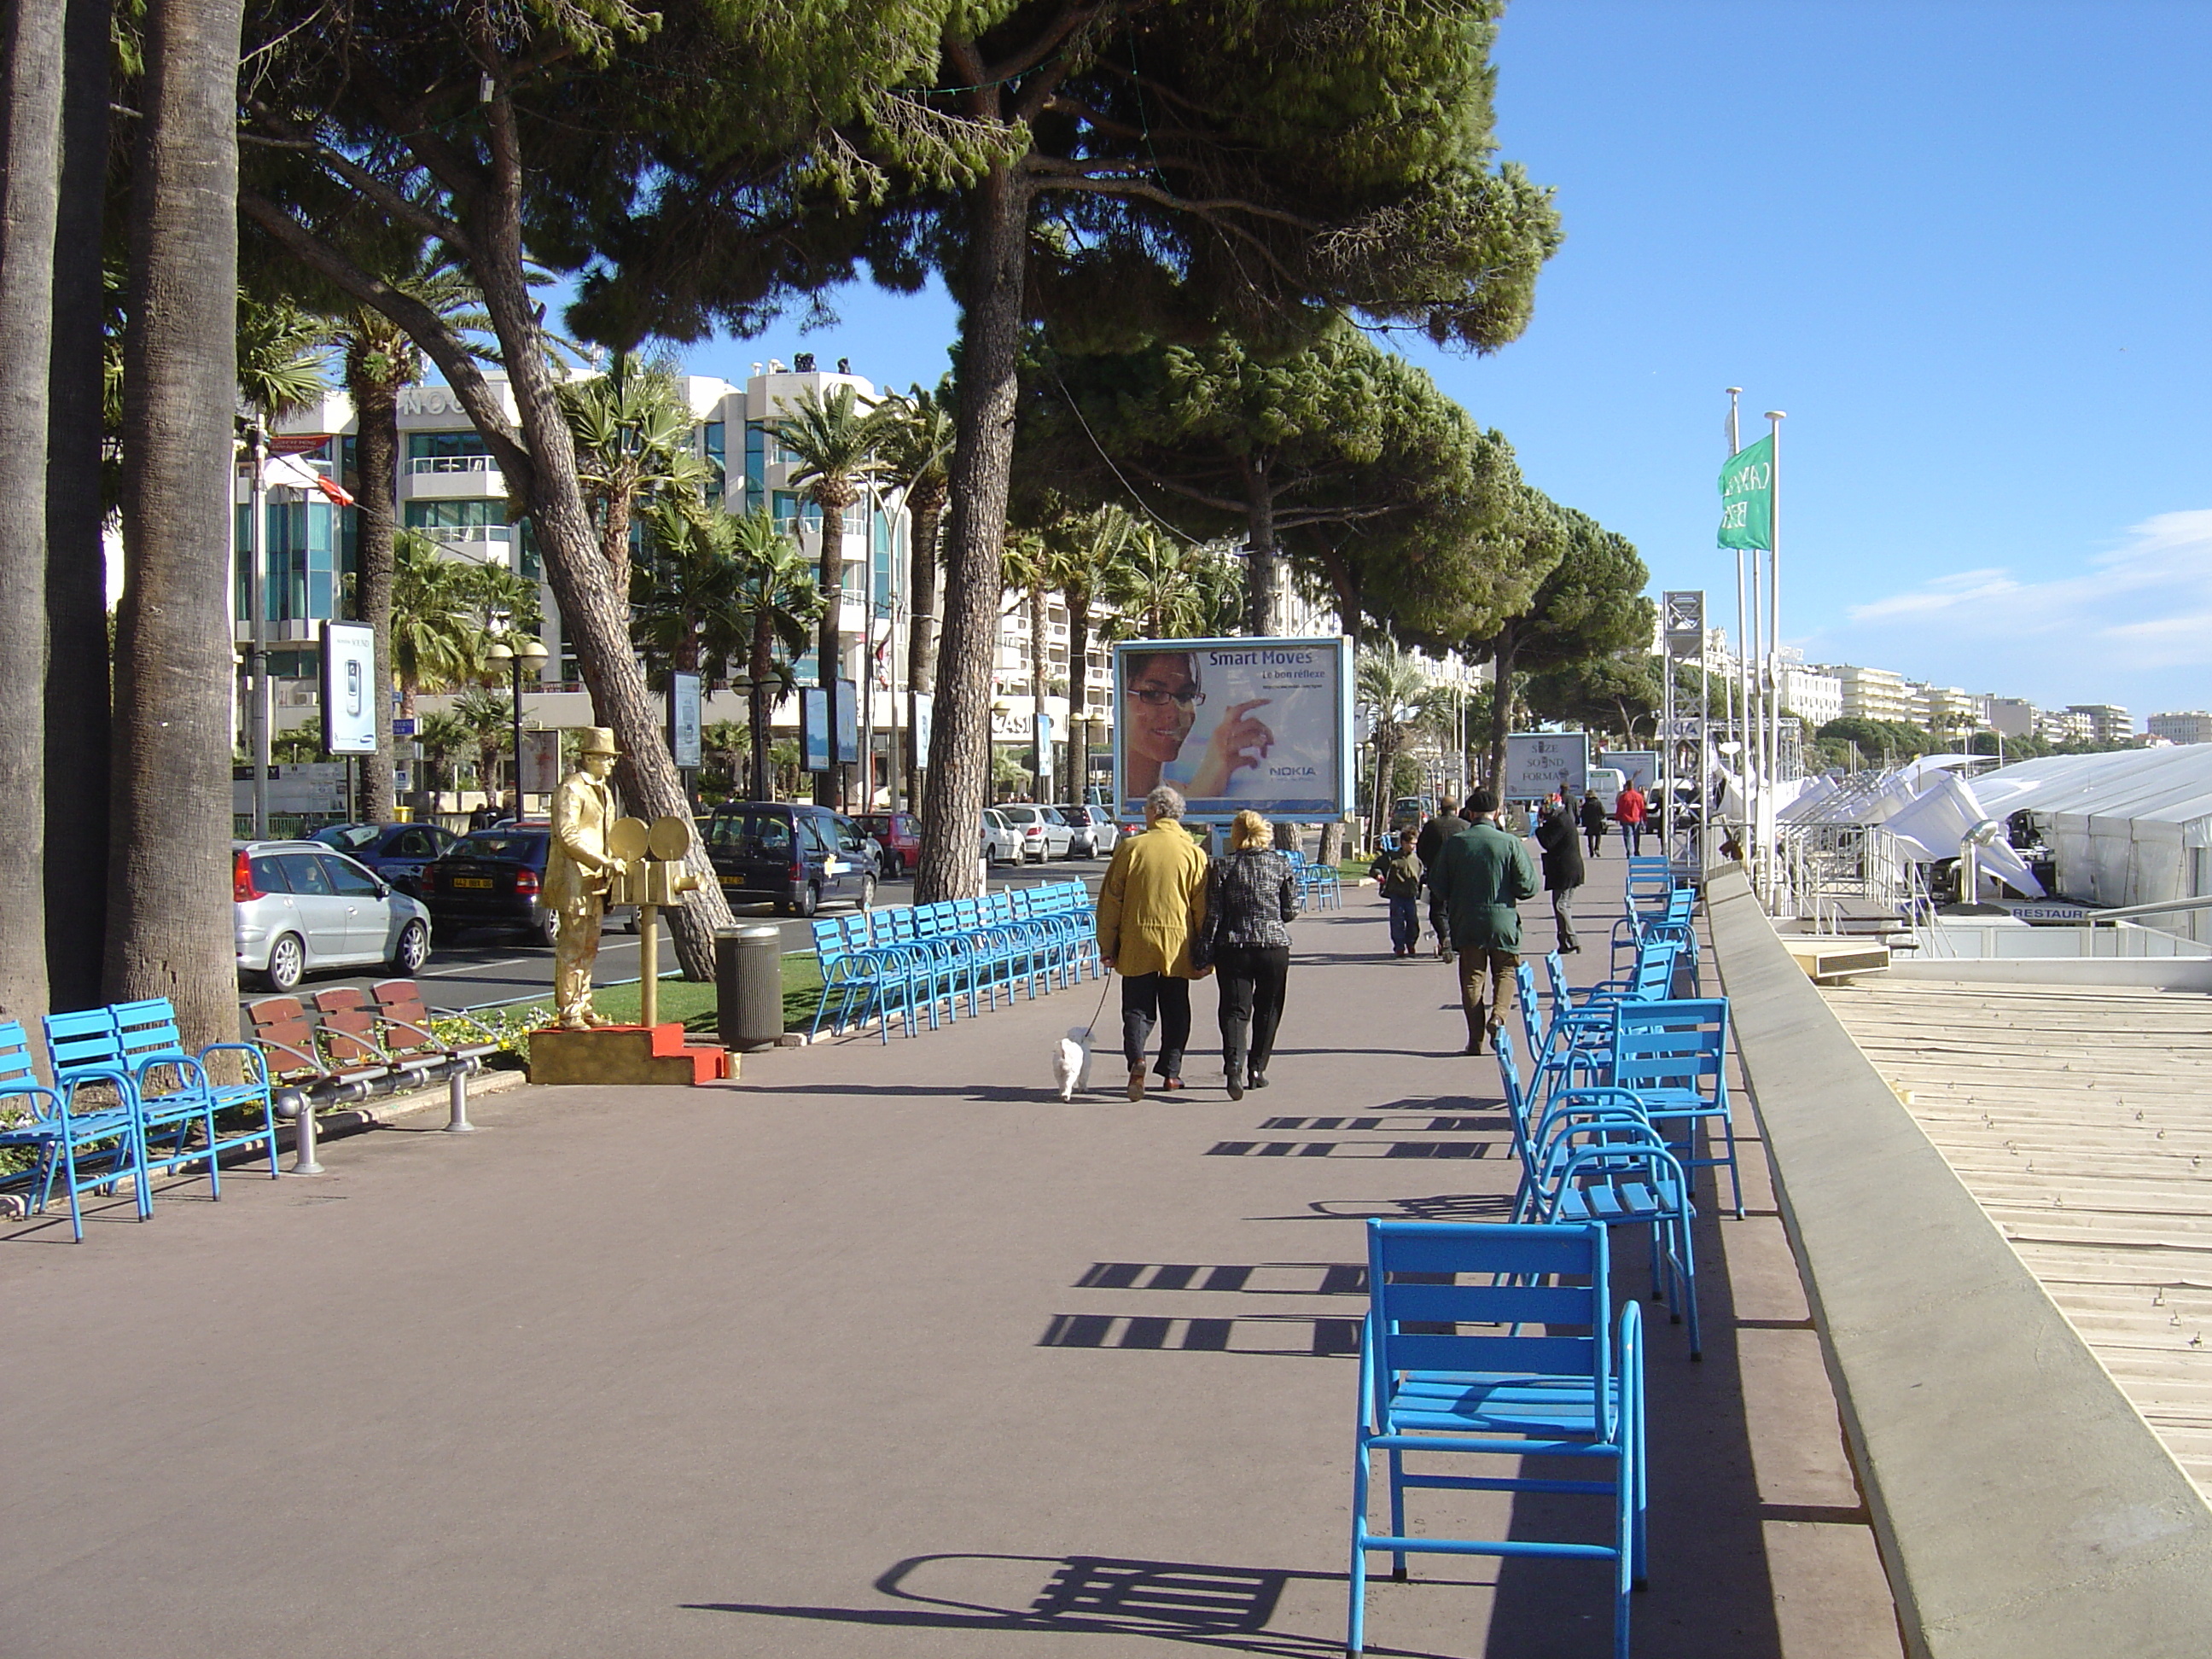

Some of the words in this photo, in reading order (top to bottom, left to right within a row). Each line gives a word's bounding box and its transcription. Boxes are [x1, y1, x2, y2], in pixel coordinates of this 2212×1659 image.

[1209, 651, 1257, 666] Smart
[1262, 650, 1313, 665] Moves
[1263, 671, 1272, 679] Le
[1275, 670, 1292, 679] bon
[1294, 669, 1325, 678] réflexe
[1270, 767, 1316, 776] NOKIA
[2013, 908, 2098, 919] RESTAUR
